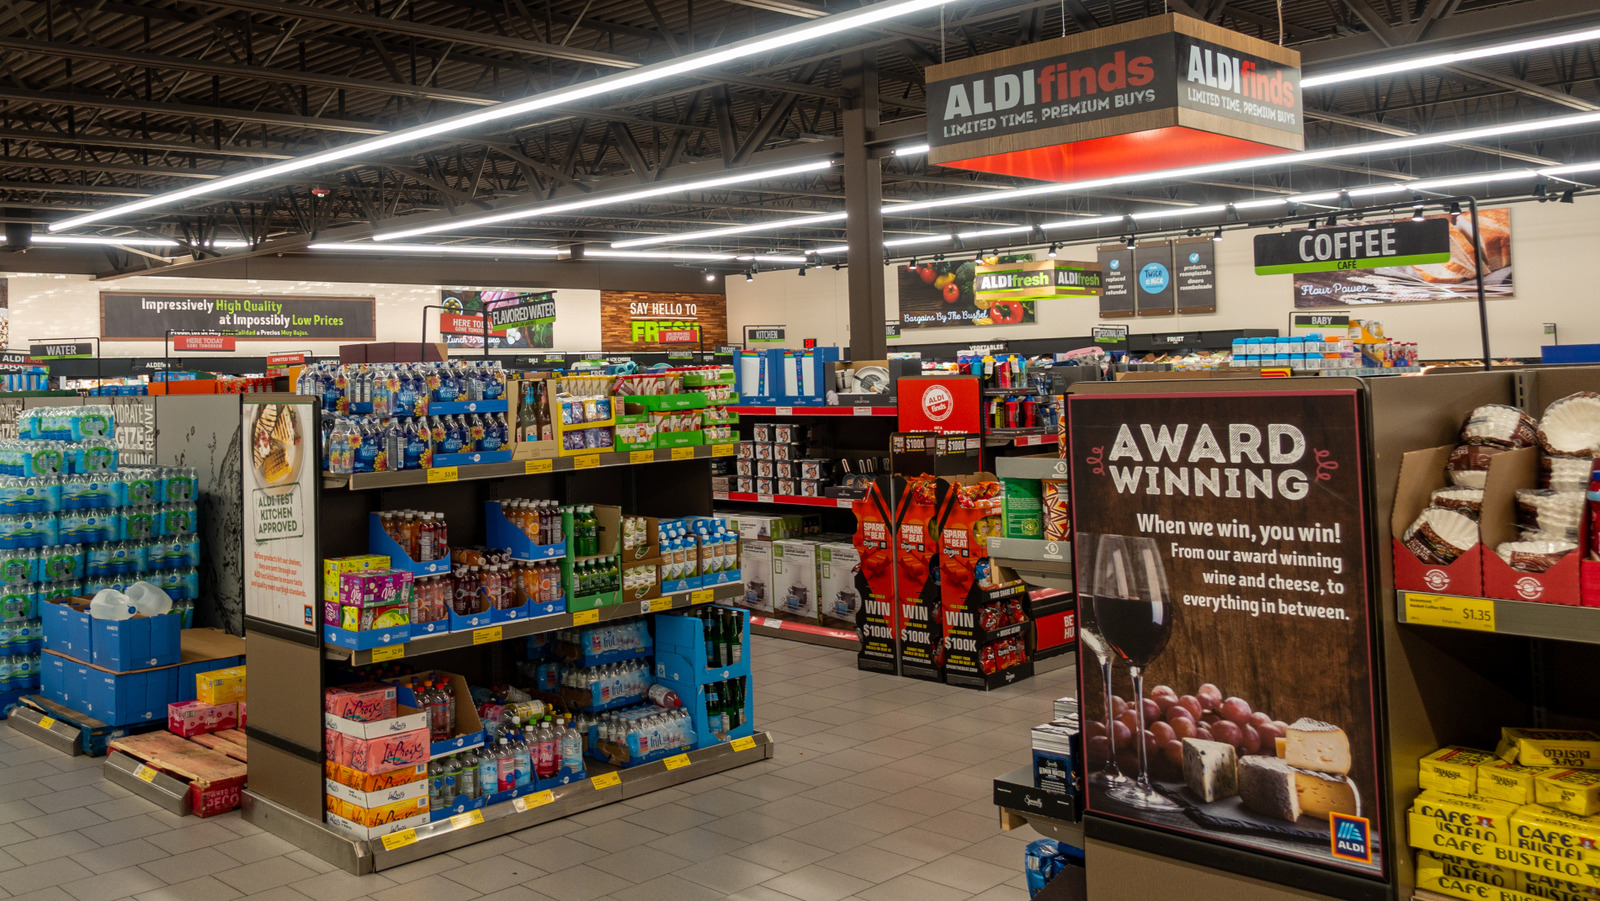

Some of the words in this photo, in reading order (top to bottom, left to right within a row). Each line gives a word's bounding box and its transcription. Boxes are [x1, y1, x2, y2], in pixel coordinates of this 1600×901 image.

[943, 50, 1154, 120] ALDIfinds
[1187, 45, 1294, 109] ALDIfinds
[943, 117, 997, 138] LIMITED
[1000, 110, 1037, 128] TIME,
[1041, 97, 1109, 121] PREMIUM
[1115, 89, 1155, 110] BUYS
[1187, 87, 1220, 107] LIMITED
[1221, 94, 1242, 113] TIME,
[1243, 100, 1276, 121] PREMIUM
[1277, 108, 1295, 125] BUYS
[1299, 227, 1396, 262] COFFEE
[1337, 257, 1357, 270] CAFÉ
[981, 272, 1049, 289] ALDIfresh
[1058, 271, 1100, 286] ALDIfresh
[1301, 283, 1331, 297] Flour
[1332, 281, 1369, 296] Power
[142, 298, 213, 313] Impressively
[216, 300, 241, 314] High
[244, 301, 282, 314] Quality
[493, 306, 528, 325] FLAVORED
[529, 302, 555, 319] WATER
[630, 303, 649, 314] SAY
[652, 303, 682, 315] HELLO
[685, 303, 696, 315] TO
[219, 315, 231, 325] at
[234, 314, 290, 328] Impossibly
[292, 315, 311, 326] Low
[314, 315, 344, 326] Prices
[453, 319, 470, 327] HERE
[904, 313, 935, 323] Bargains
[936, 311, 947, 323] By
[947, 310, 961, 320] The
[961, 308, 989, 320] Bushel
[1311, 315, 1332, 326] BABY
[756, 331, 777, 339] KITCHEN
[46, 345, 77, 355] WATER
[929, 394, 944, 403] ALDI
[931, 403, 946, 413] finds
[145, 404, 153, 450] REVIVE
[1109, 423, 1306, 465] AWARD
[1109, 465, 1309, 500] WINNING
[258, 495, 274, 507] ALDI
[276, 493, 294, 505] TEST
[260, 507, 293, 520] KITCHEN
[258, 520, 298, 534] APPROVED
[864, 522, 885, 532] SPARK
[901, 524, 923, 534] SPARK
[944, 530, 967, 539] SPARK
[1137, 513, 1186, 535] When
[1189, 522, 1214, 537] we
[1217, 519, 1257, 541] win,
[1259, 524, 1294, 546] you
[1298, 522, 1341, 544] win!
[871, 532, 885, 540] BEAT
[909, 534, 923, 543] BEAT
[952, 539, 967, 548] BEAT
[1171, 543, 1204, 560] From
[1206, 549, 1231, 562] our
[1233, 548, 1277, 565] award
[1280, 551, 1342, 574] winning
[1203, 570, 1236, 587] wine
[1238, 571, 1266, 588] and
[1268, 573, 1324, 596] cheese,
[1327, 579, 1344, 594] to
[865, 600, 890, 616] WIN
[902, 604, 928, 621] WIN
[1183, 593, 1259, 617] everything
[1262, 598, 1276, 613] in
[1278, 599, 1350, 621] between.
[1463, 608, 1491, 621] $1.35
[945, 611, 974, 628] WIN
[863, 623, 893, 639] $100K
[901, 628, 930, 644] $100K
[945, 636, 977, 652] $100K
[1337, 840, 1364, 853] ALDI
[1495, 847, 1580, 877] BUSTELO
